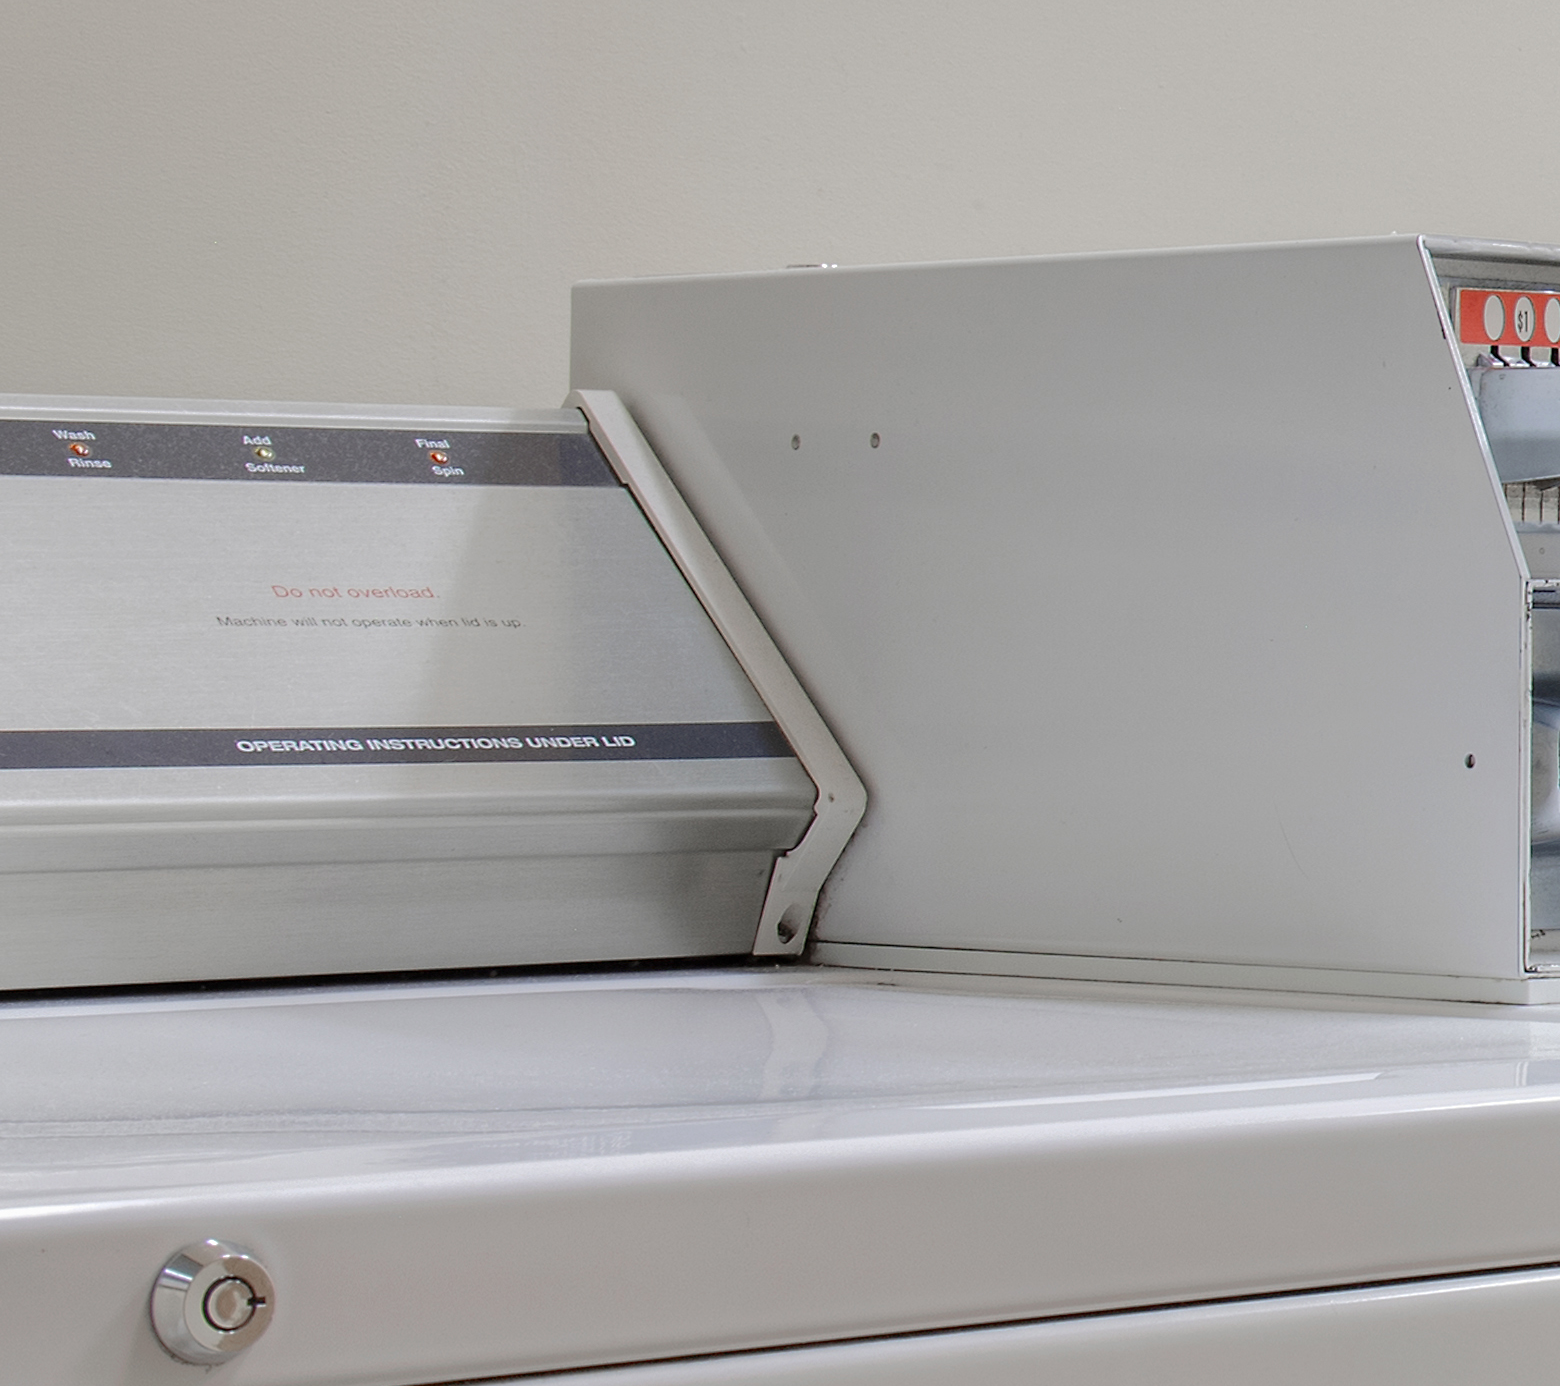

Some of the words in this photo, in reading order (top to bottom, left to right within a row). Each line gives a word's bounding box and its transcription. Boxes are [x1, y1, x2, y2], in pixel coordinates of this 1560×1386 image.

[1517, 310, 1529, 334] $1
[53, 429, 96, 441] Wash
[242, 435, 272, 446] Add
[415, 438, 450, 450] Final
[68, 458, 112, 470] Rinse
[245, 462, 305, 475] Softener
[431, 465, 465, 478] Spin
[271, 585, 302, 599] Do
[308, 586, 341, 599] not
[347, 585, 440, 600] overload.
[216, 616, 287, 627] Machine
[292, 617, 318, 628] will
[321, 617, 348, 628] not
[351, 617, 412, 630] operate
[416, 616, 459, 628] when
[461, 616, 481, 628] lid
[483, 617, 498, 628] is
[236, 738, 364, 754] OPERATING
[366, 736, 523, 752] INSTRUCTIONS
[525, 735, 600, 750] UNDER
[602, 735, 636, 749] LID
